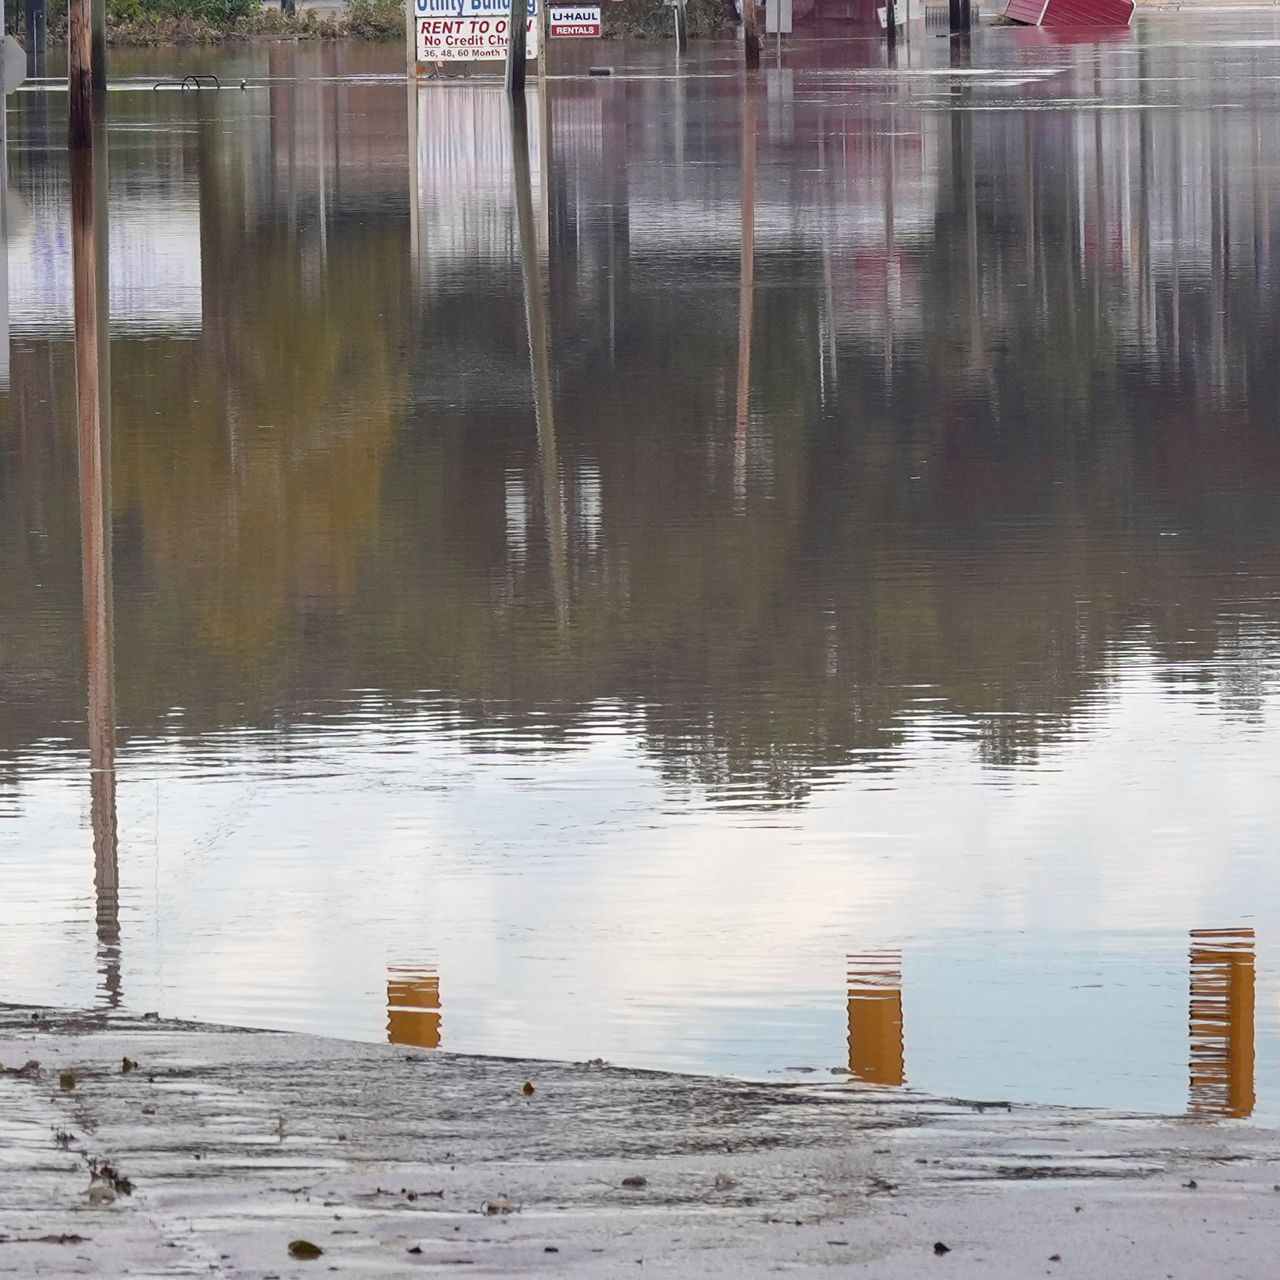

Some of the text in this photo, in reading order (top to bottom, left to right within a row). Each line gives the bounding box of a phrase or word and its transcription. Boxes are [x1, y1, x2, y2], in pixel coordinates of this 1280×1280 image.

[552, 12, 598, 21] U-HAUL
[421, 21, 464, 34] RENT
[469, 21, 490, 34] TO
[556, 26, 595, 35] RENTALS
[424, 36, 441, 46] No
[445, 35, 484, 46] Credit
[424, 49, 438, 58] 36,
[441, 49, 455, 58] 48,
[457, 49, 469, 57] 60
[472, 48, 500, 57] Month
